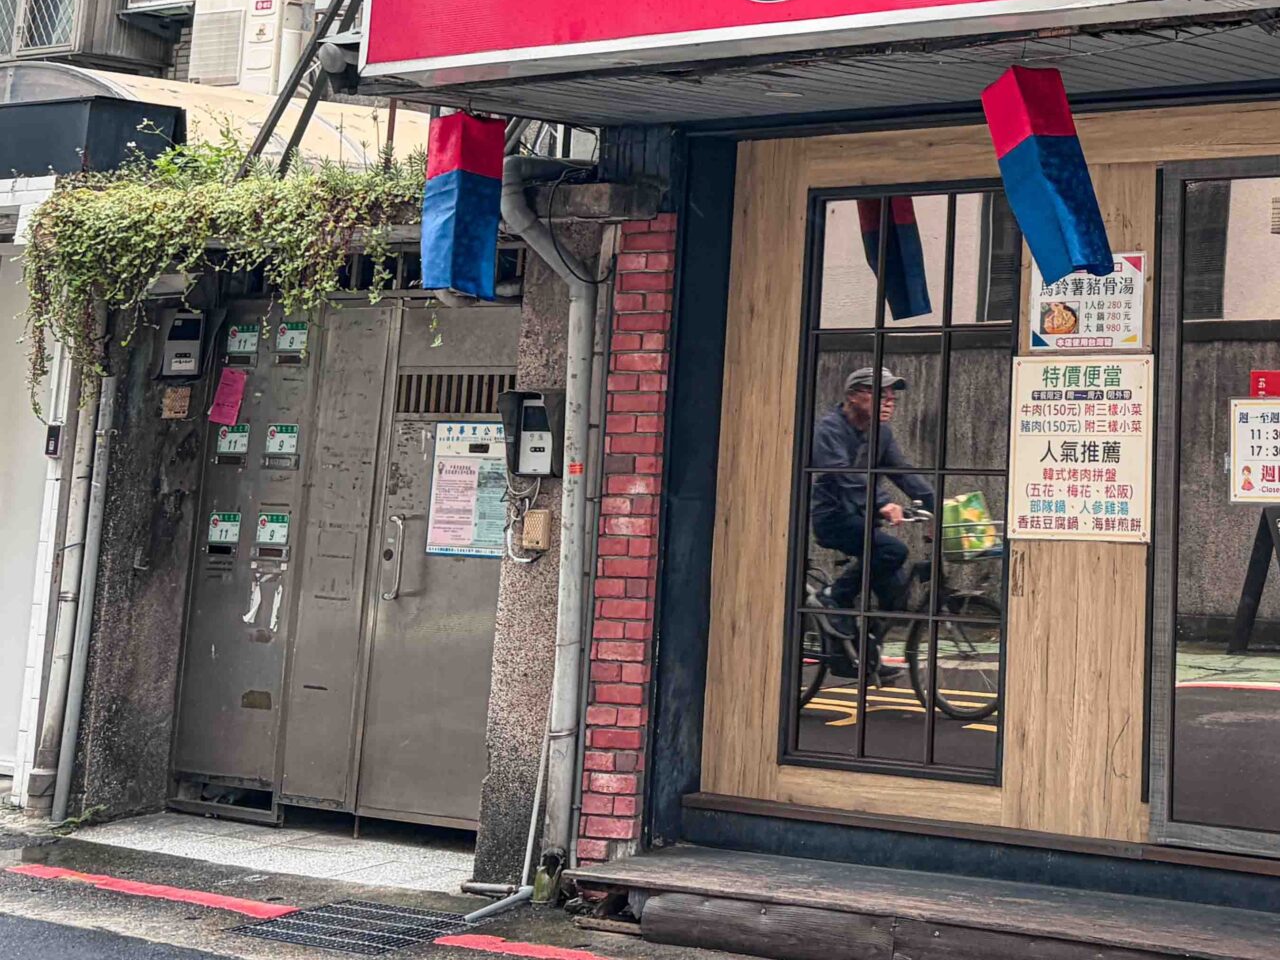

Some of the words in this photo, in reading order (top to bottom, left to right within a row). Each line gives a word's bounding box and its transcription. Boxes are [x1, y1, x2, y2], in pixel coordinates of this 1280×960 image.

[1107, 311, 1121, 321] 780
[1106, 322, 1121, 332] 980
[1042, 365, 1122, 388] 特價便當
[1021, 403, 1081, 417] 牛肉(150元)
[1040, 440, 1121, 464] 人氣推薦
